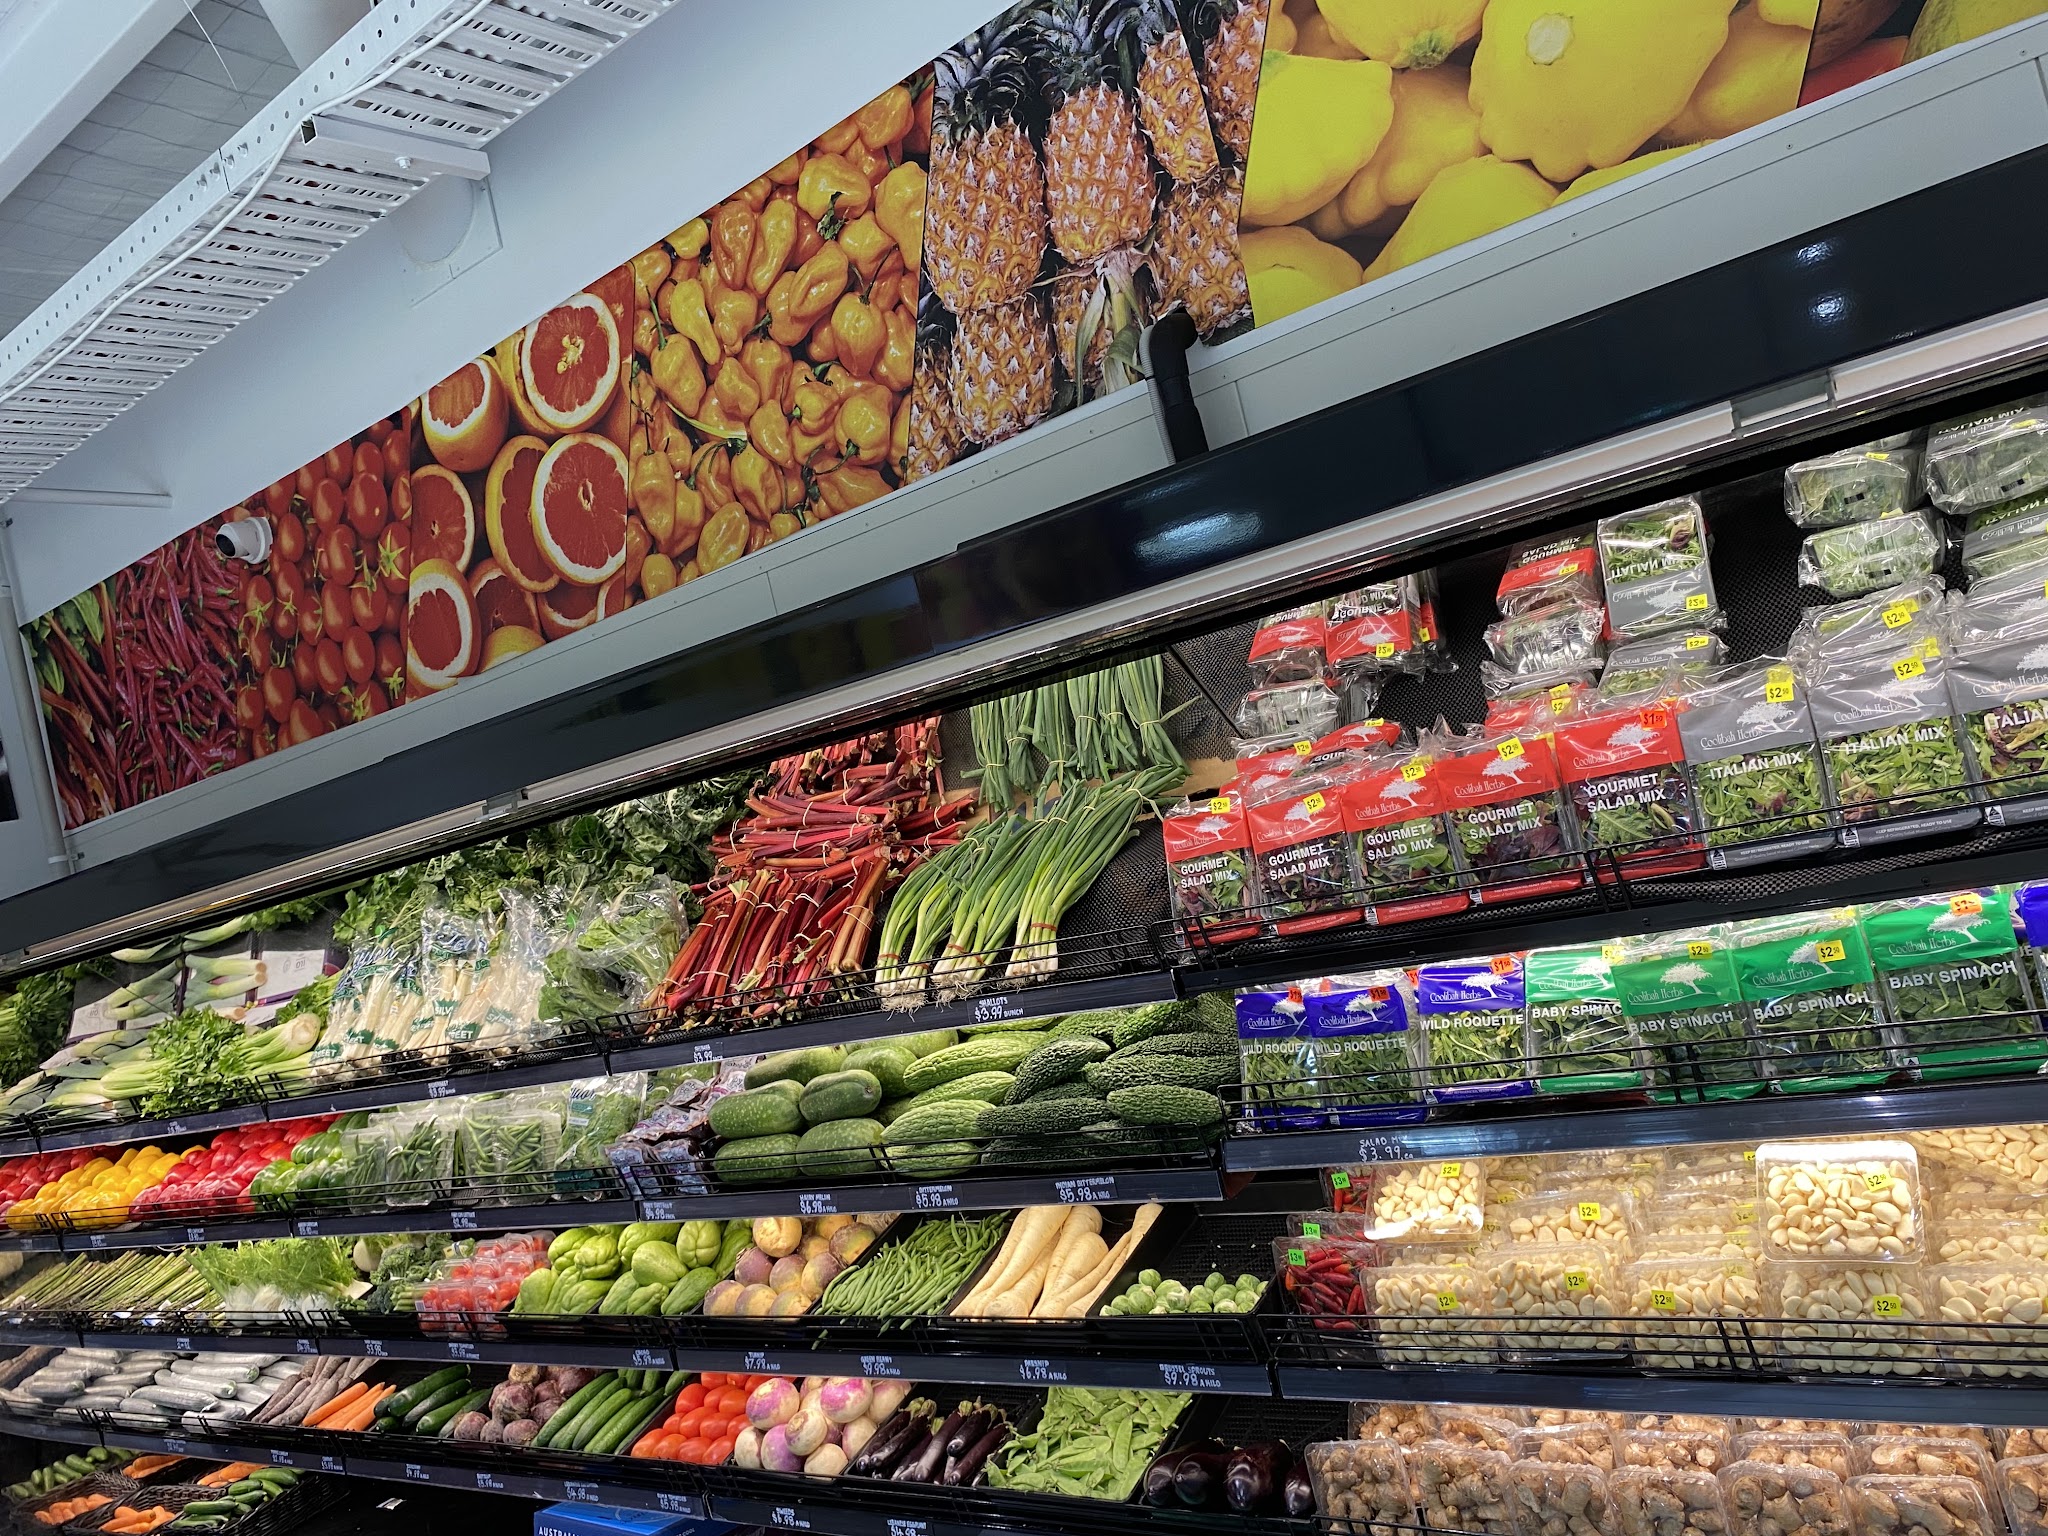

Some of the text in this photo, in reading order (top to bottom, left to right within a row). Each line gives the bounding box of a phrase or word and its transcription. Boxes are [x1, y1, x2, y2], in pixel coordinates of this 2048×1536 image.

[2018, 672, 2048, 688] Herbs
[1833, 701, 1902, 723] Coolibah Herbs
[1700, 733, 1736, 749] Coolibah
[1846, 725, 1946, 754] ITALIAN MIX
[1710, 751, 1803, 780] ITALIAN MIX
[1454, 778, 1506, 797] Coolibah Herbs
[1587, 773, 1658, 798] GOURMET
[1355, 800, 1402, 819] Coolibah Herbs
[1587, 789, 1666, 813] SALAD MIX
[1468, 802, 1534, 825] GOURMET
[1367, 824, 1427, 846] GOURMET
[1469, 817, 1542, 840] SALAD MIX
[1269, 843, 1324, 866] GOURMET
[1367, 838, 1435, 861] SALAD MIX
[1181, 857, 1229, 875] GOURMET
[1269, 856, 1331, 880] SALAD MIX
[1181, 870, 1234, 889] SALAD MIX
[1889, 936, 1957, 955] Coolibah Herbs
[1753, 967, 1814, 987] Coolibah Herbs
[1889, 972, 1935, 989] BABY
[1939, 960, 2019, 984] SPINACH
[979, 996, 1008, 1008] SHALLOTS
[1430, 989, 1481, 1003] Coolibah Herbs
[1627, 987, 1684, 1004] Coolibah Herbs
[975, 1005, 1003, 1022] $3.99
[1532, 1006, 1568, 1019] BABY
[1753, 991, 1869, 1020] BABY SPINACH
[1420, 1013, 1524, 1031] WILD ROQUETTE
[1629, 1010, 1734, 1035] BABY SPINACH
[1241, 1044, 1263, 1055] WILD
[1315, 1037, 1408, 1054] WILD ROQUETTE
[1359, 1136, 1388, 1148] SALAD
[915, 1191, 942, 1208] $5.98
[1060, 1187, 1092, 1203] $5.98
[1019, 1365, 1047, 1380] $6.98
[1164, 1371, 1198, 1387] $9.98
[1187, 1366, 1215, 1376] SPROUTS
